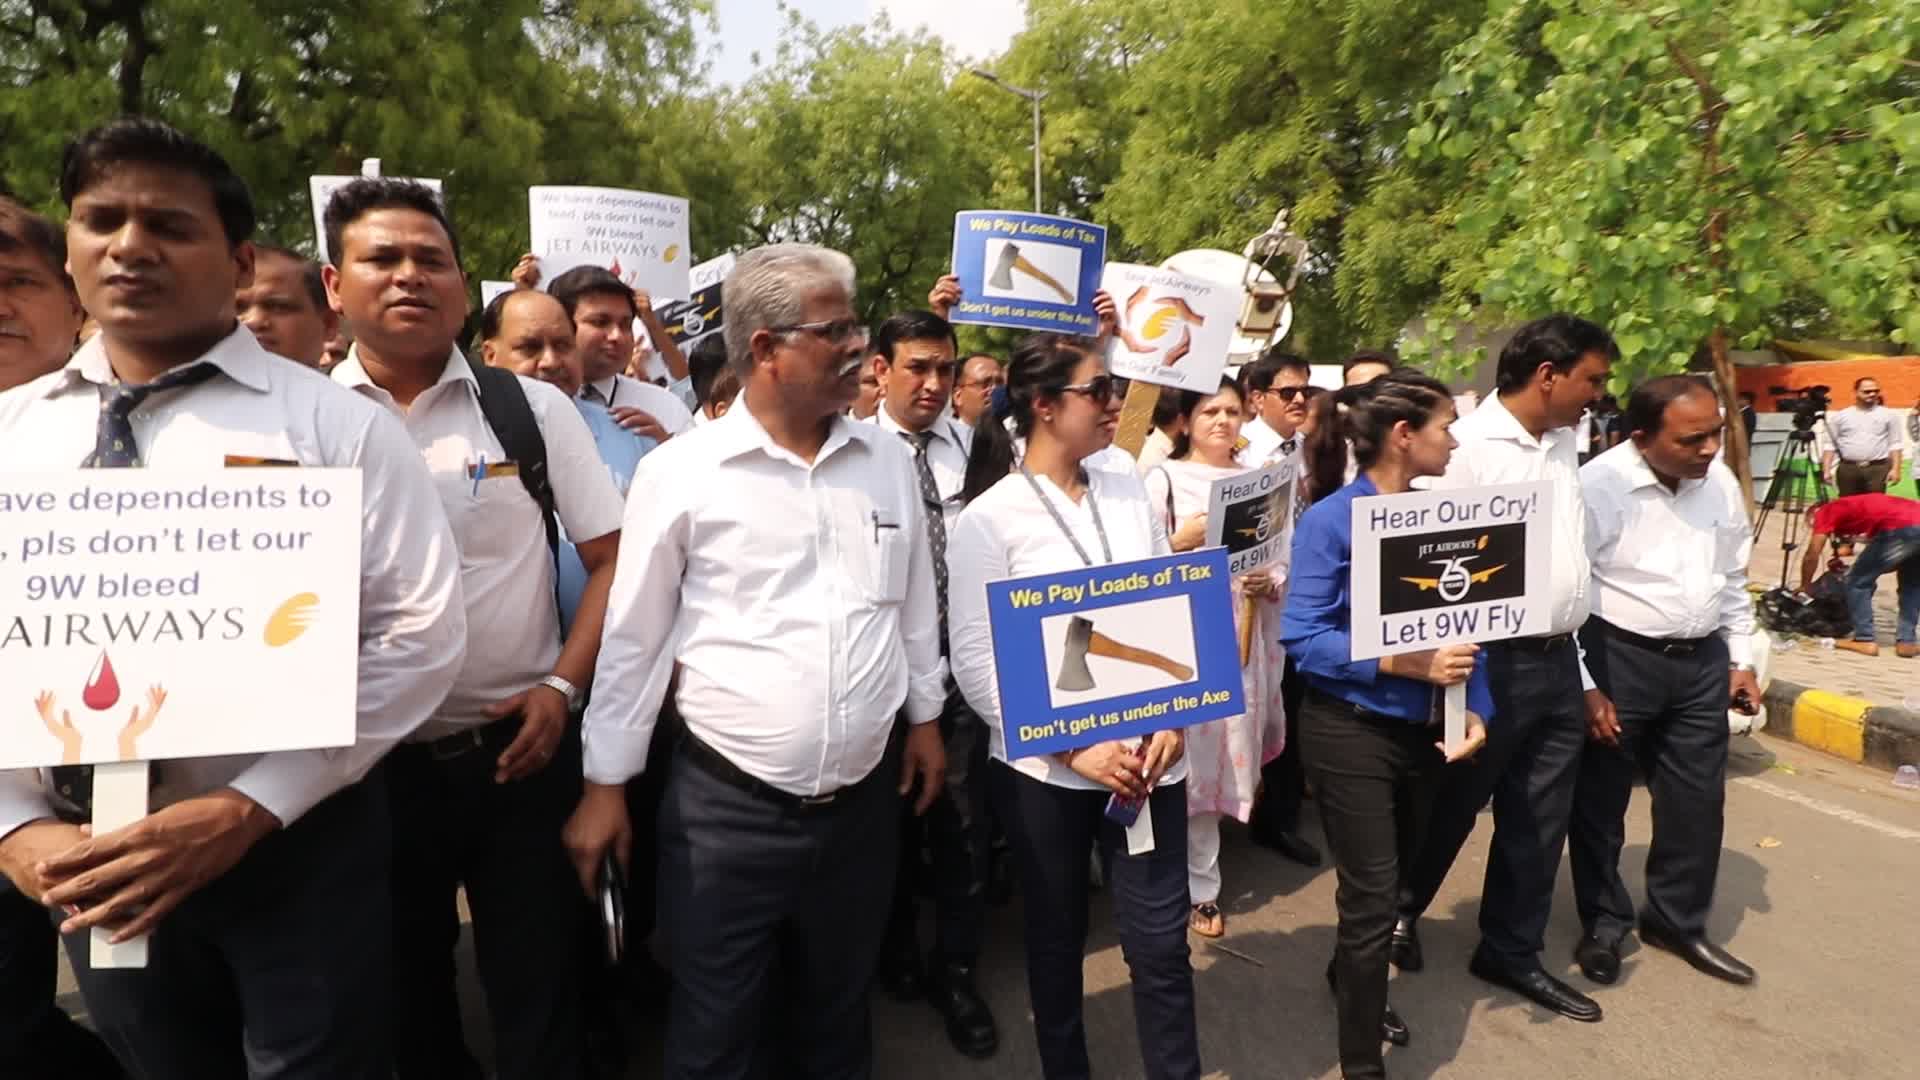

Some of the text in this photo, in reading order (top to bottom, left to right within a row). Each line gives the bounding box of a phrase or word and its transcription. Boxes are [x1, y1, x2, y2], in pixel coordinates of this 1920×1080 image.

[969, 217, 1097, 244] We Pay Loads of Tax
[546, 239, 659, 258] JET AIRWAYS
[959, 301, 990, 313] Don't
[991, 304, 1010, 317] get
[1011, 307, 1025, 317] us
[1026, 307, 1057, 320] under
[1057, 310, 1074, 322] the
[0, 484, 332, 517] ave dependents to
[1220, 481, 1257, 502] Hear
[1370, 492, 1537, 531] Hear Our Cry!
[22, 527, 313, 563] pls don't let our
[1418, 538, 1477, 558] JET AIRWAYS
[1230, 553, 1247, 573] et
[26, 570, 200, 601] 9W bleed
[1009, 564, 1212, 608] We Pay Loads of Tax
[0, 607, 245, 649] AIRWAYS
[1382, 604, 1526, 646] Let 9W Fly
[1019, 688, 1231, 742] Don't get us under the Axe
